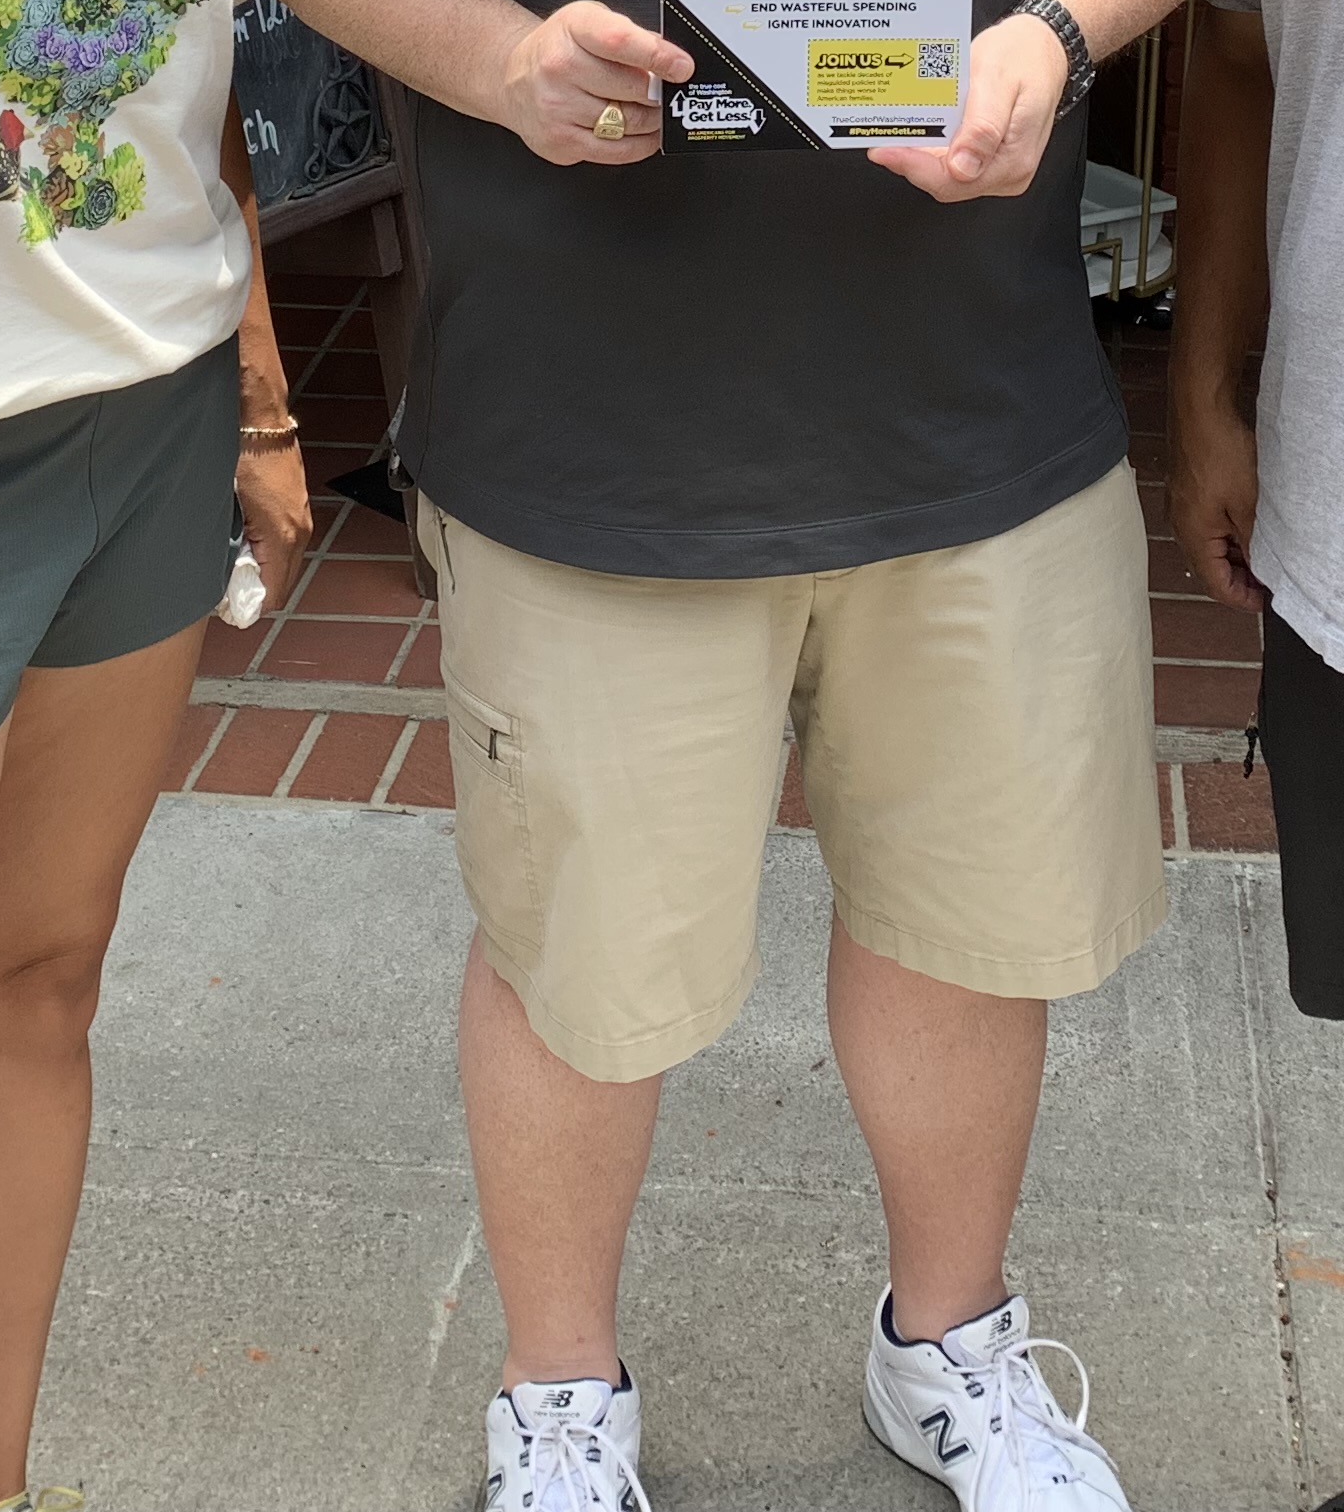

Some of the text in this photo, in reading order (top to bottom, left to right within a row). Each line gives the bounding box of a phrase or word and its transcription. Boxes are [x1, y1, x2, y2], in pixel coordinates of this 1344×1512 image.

[751, 2, 917, 13] END WASTEFUL SPENDING
[768, 19, 891, 29] IGNITE INNOVATION
[815, 53, 883, 68] JOIN US
[689, 99, 713, 110] Pay
[689, 112, 714, 122] Get
[849, 127, 926, 136] #PayMoreGetLess
